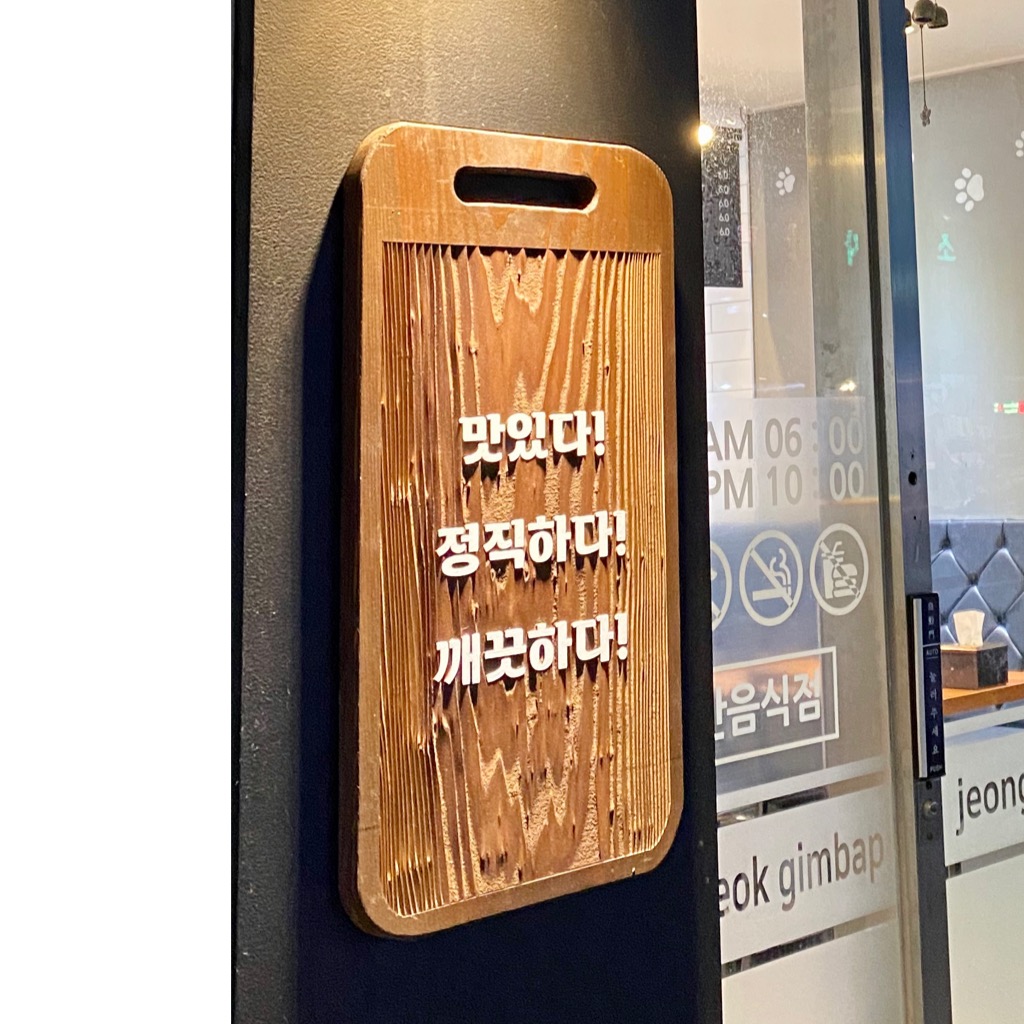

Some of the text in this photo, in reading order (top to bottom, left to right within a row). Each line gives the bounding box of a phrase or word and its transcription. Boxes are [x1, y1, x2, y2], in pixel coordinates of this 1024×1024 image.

[458, 409, 606, 466] 맛있다!
[707, 419, 753, 461] AM
[435, 509, 628, 577] 정직하다!
[433, 610, 629, 686] 깨끗하다!
[779, 832, 884, 912] gimbap
